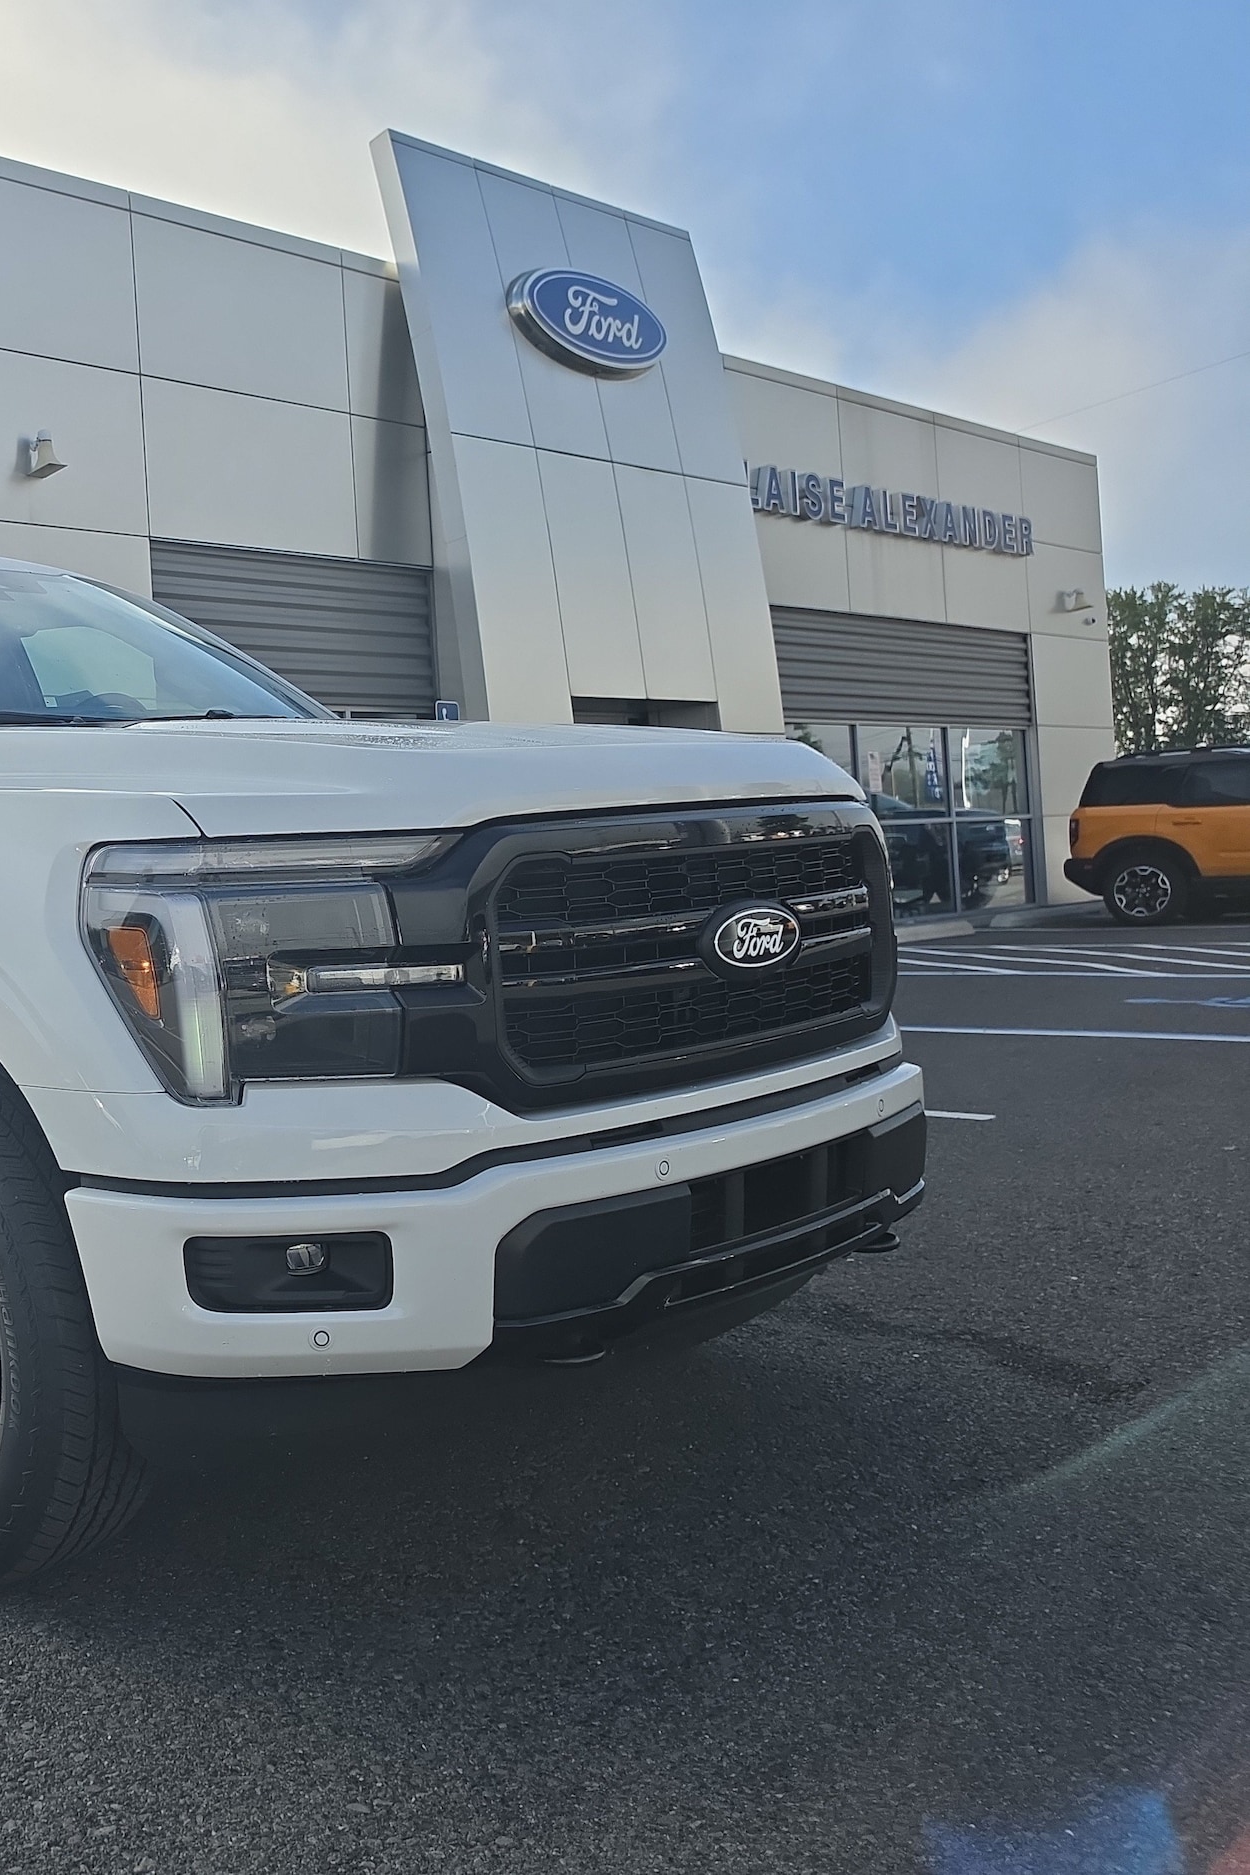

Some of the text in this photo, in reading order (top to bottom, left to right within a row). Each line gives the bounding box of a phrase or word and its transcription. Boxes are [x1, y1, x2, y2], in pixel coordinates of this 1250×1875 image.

[564, 285, 642, 350] Ford
[749, 464, 1034, 555] AISE ALEXANDER
[733, 917, 784, 959] Ford
